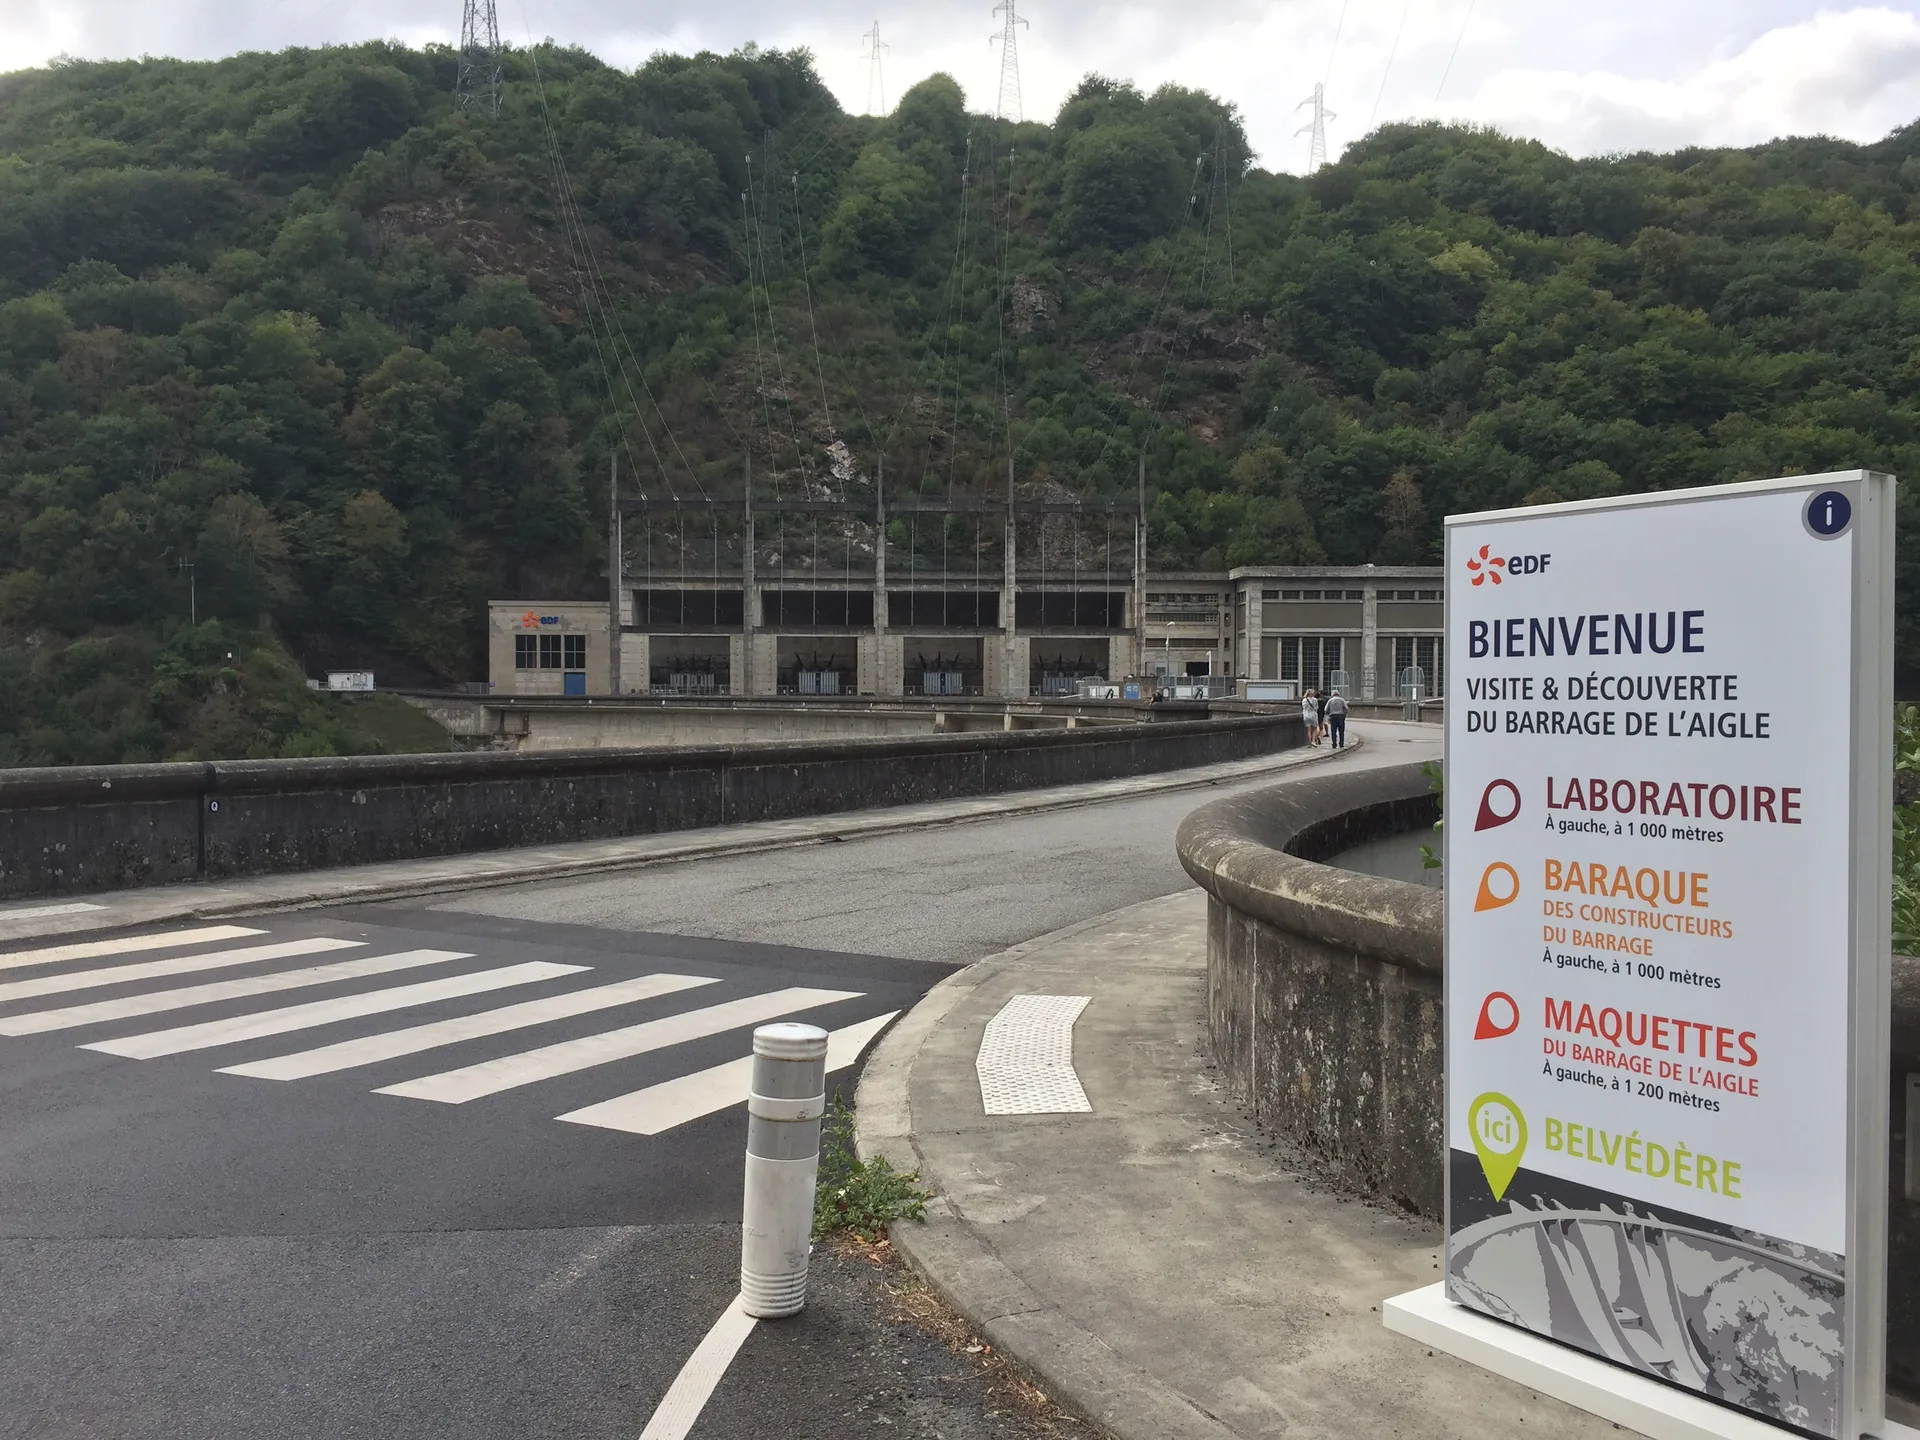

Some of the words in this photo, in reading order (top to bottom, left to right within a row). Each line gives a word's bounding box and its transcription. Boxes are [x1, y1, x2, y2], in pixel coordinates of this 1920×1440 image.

[1469, 609, 1705, 659] BIENVENUE
[1466, 676, 1534, 701] VISITE
[1542, 676, 1559, 701] &
[1568, 671, 1738, 701] DÉCOUVERTE
[1467, 710, 1497, 733] DU
[1505, 710, 1615, 736] BARRAGE
[1625, 712, 1658, 737] DE
[1668, 711, 1771, 739] L'AIGLE
[1546, 776, 1802, 825] LABORATOIRE
[1545, 813, 1555, 830] À
[1558, 818, 1610, 837] gauche,
[1614, 820, 1623, 836] à
[1671, 825, 1724, 843] mètres
[1545, 858, 1709, 908] BARAQUE
[1543, 900, 1574, 920] DES
[1580, 903, 1733, 939] CONSTRUCTEURS
[1543, 925, 1566, 945] DU
[1572, 928, 1653, 957] BARRAGE
[1542, 947, 1553, 964] À
[1556, 952, 1608, 974] gauche,
[1612, 959, 1621, 974] à
[1669, 968, 1721, 989] mètres
[1545, 997, 1758, 1067] MAQUETTES
[1542, 1059, 1553, 1076] À
[1556, 1066, 1607, 1090] gauche,
[1611, 1075, 1620, 1090] à
[1669, 1090, 1720, 1113] mètres
[1543, 1037, 1566, 1057] DU
[1572, 1043, 1652, 1076] BARRAGE
[1659, 1060, 1682, 1081] DE
[1690, 1066, 1759, 1097] L'AIGLE
[1484, 1110, 1511, 1144] ici
[1545, 1117, 1742, 1199] BELVÉDÈRE
